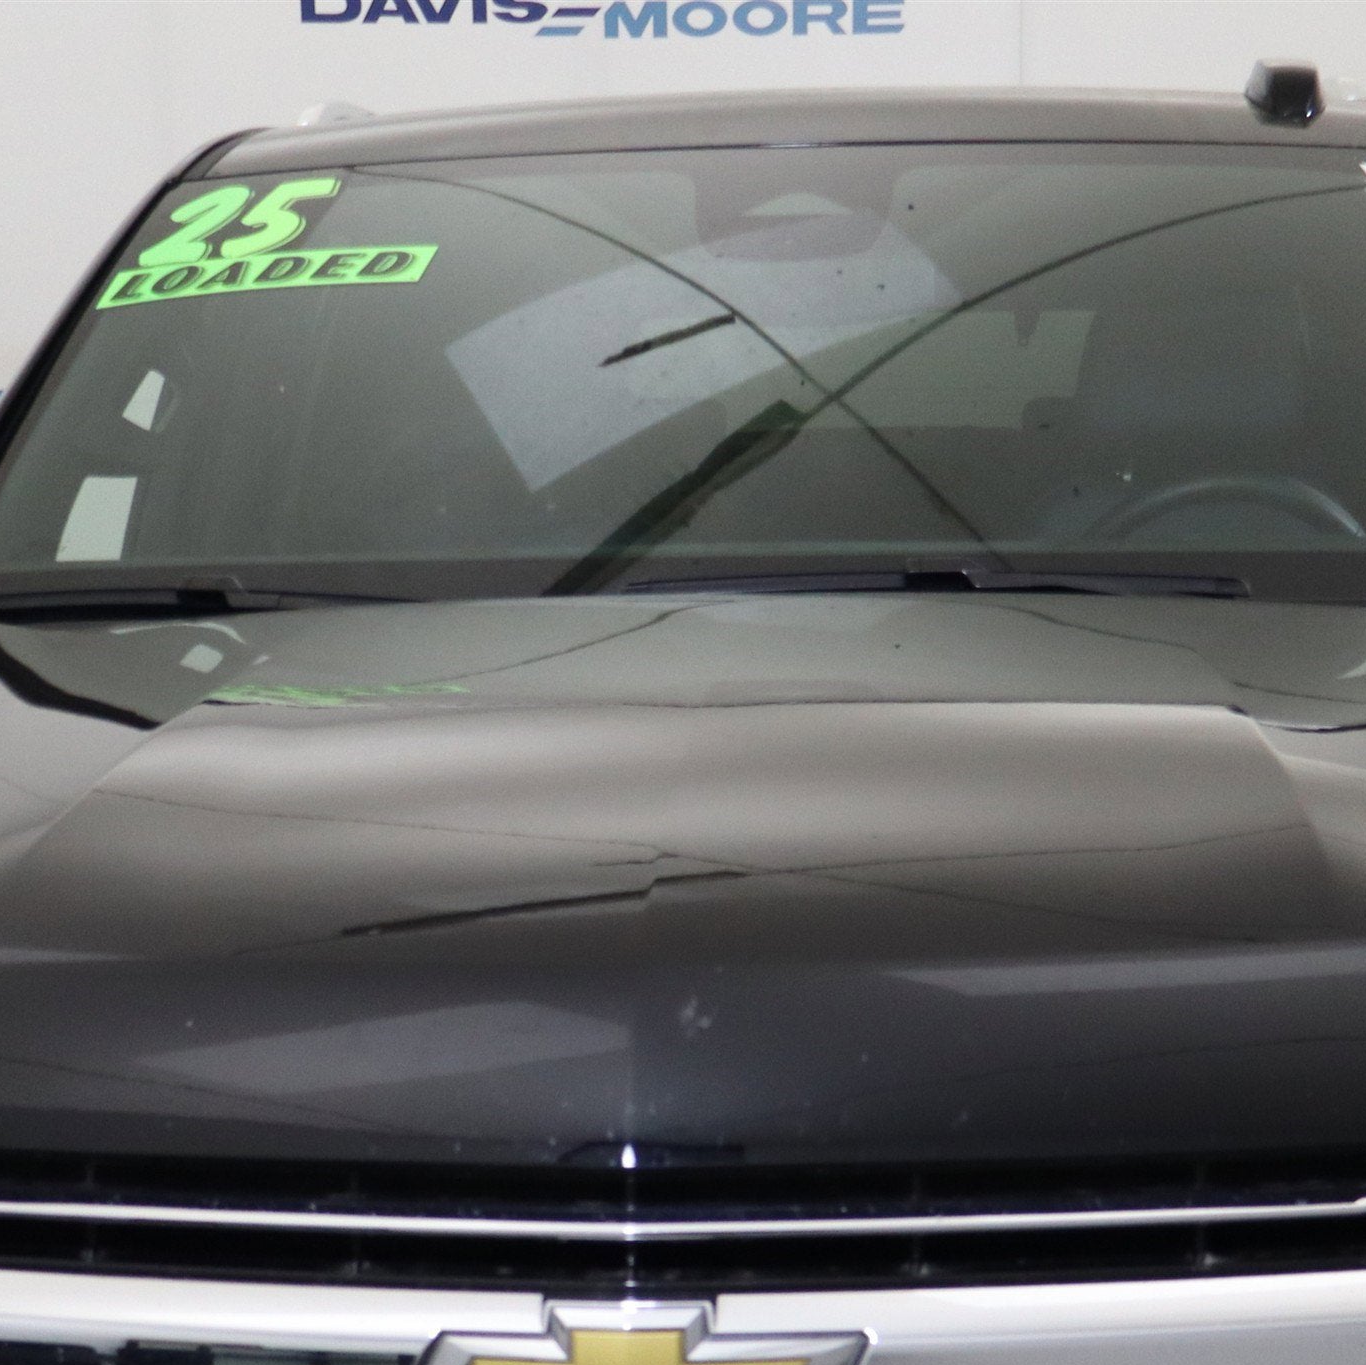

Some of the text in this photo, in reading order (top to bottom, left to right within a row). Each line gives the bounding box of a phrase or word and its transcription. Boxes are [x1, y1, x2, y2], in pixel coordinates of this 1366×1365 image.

[300, 0, 905, 38] DAVIS MOORE
[138, 178, 342, 268] 25
[109, 251, 416, 302] LOADED
